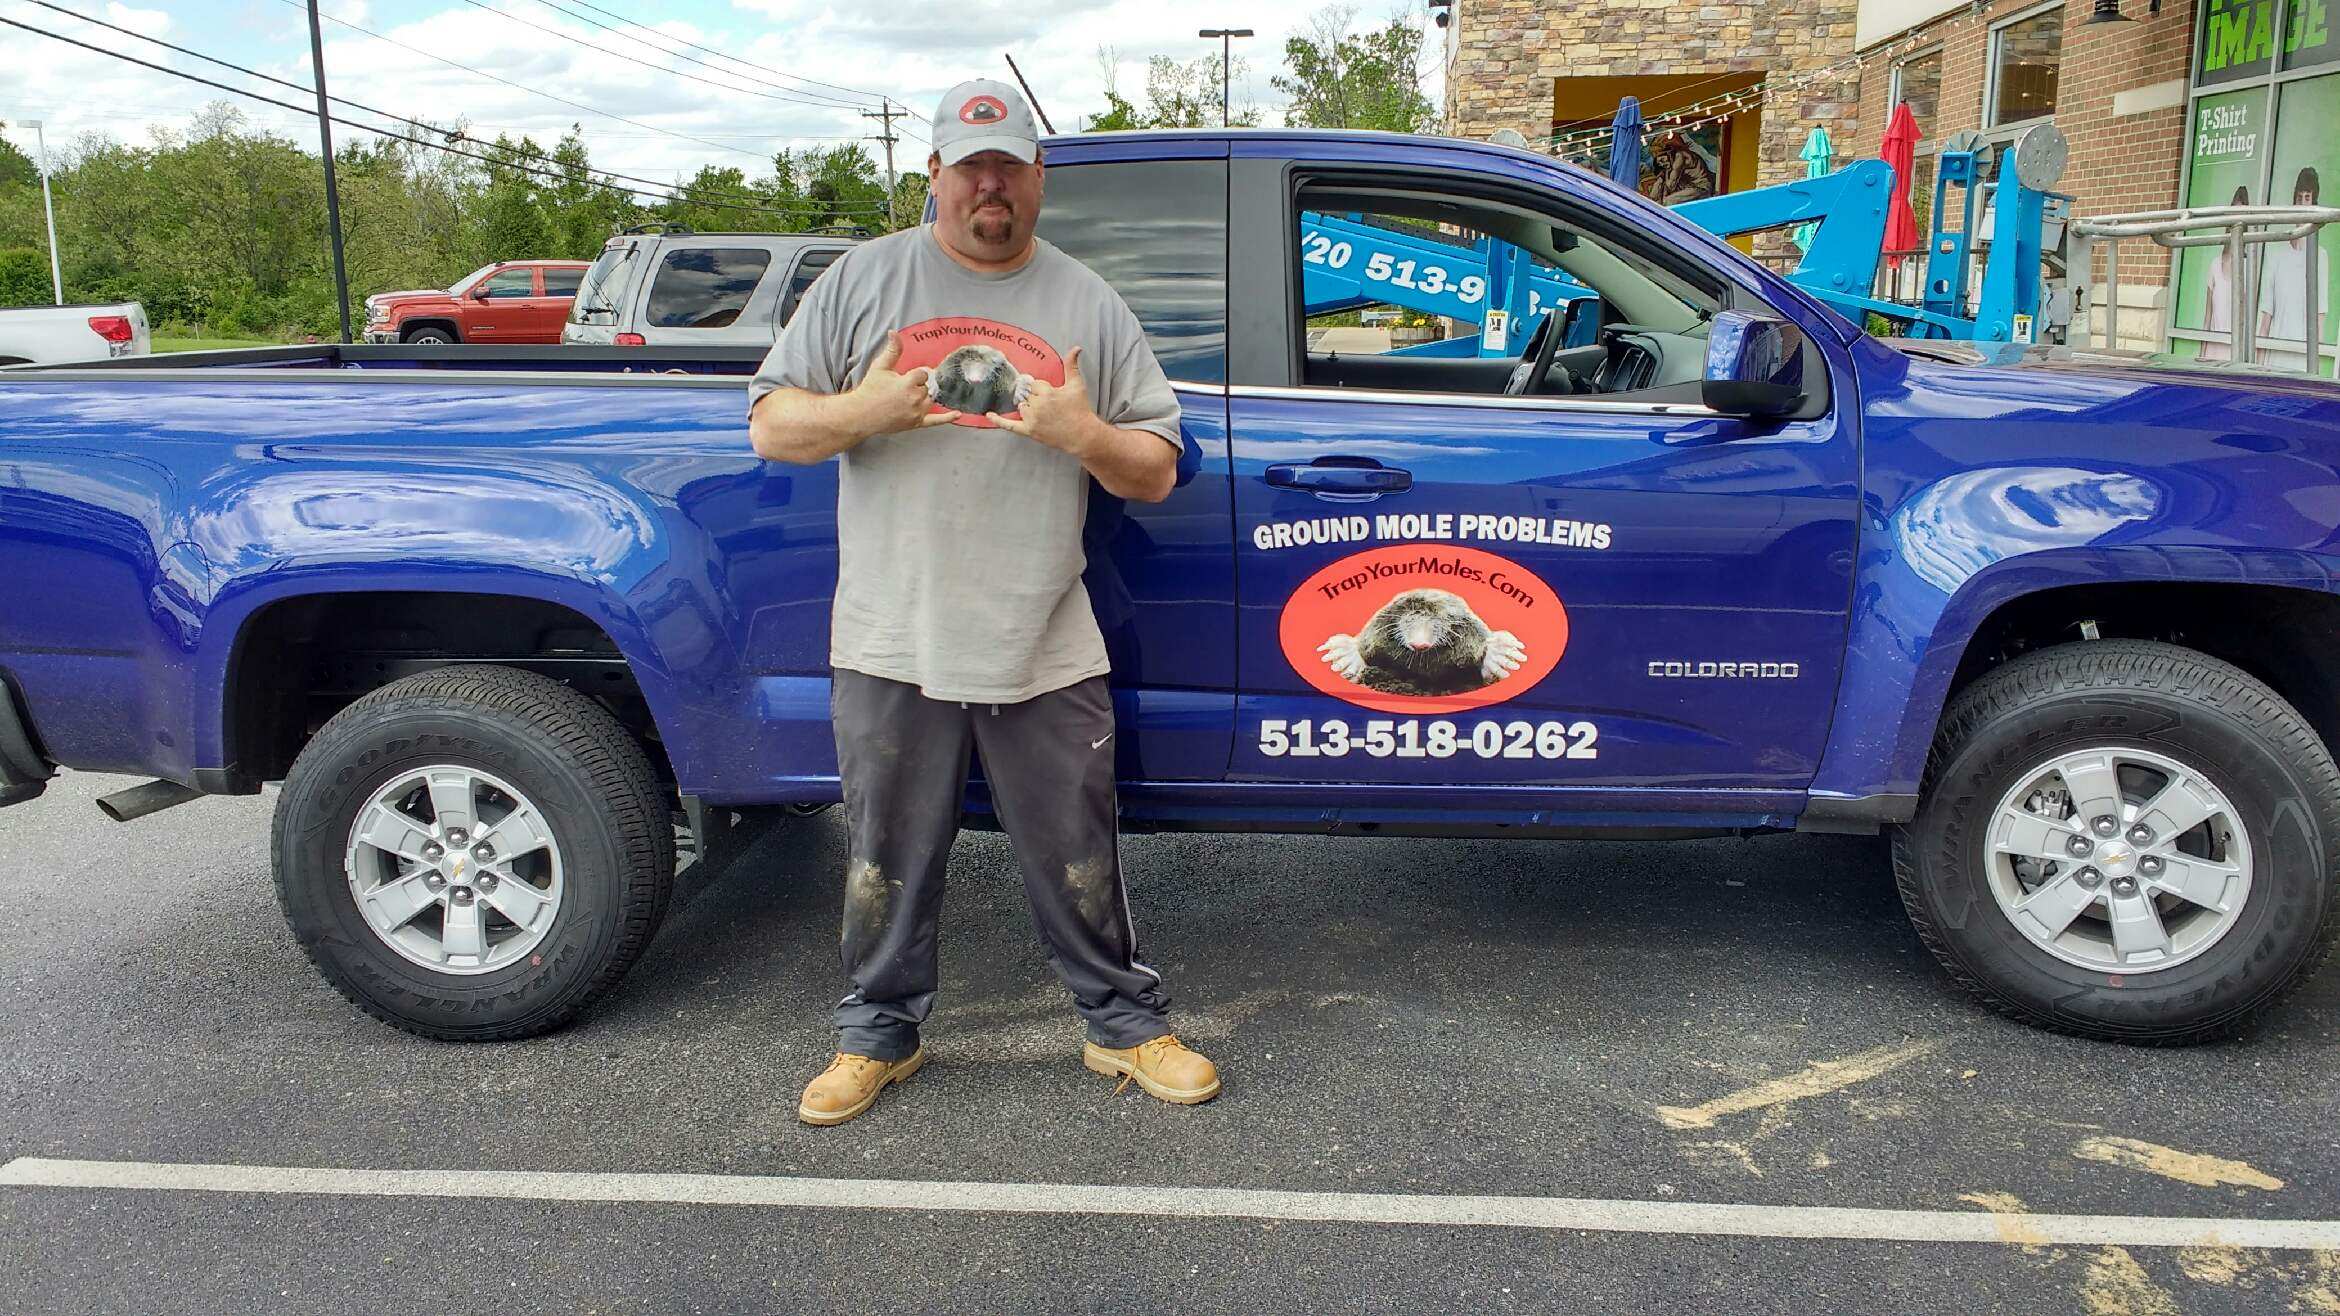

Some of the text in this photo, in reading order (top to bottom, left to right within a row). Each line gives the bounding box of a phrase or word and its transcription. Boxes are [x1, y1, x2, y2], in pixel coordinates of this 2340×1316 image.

[2200, 104, 2248, 131] T-Shirt
[2197, 130, 2256, 157] Printing
[1253, 514, 1612, 550] GROUND MOLE PROBLEMS
[1317, 556, 1535, 609] TrapYourMoles.Com
[1648, 661, 1799, 678] COLORADO
[1258, 719, 1598, 759] 513-518-0262
